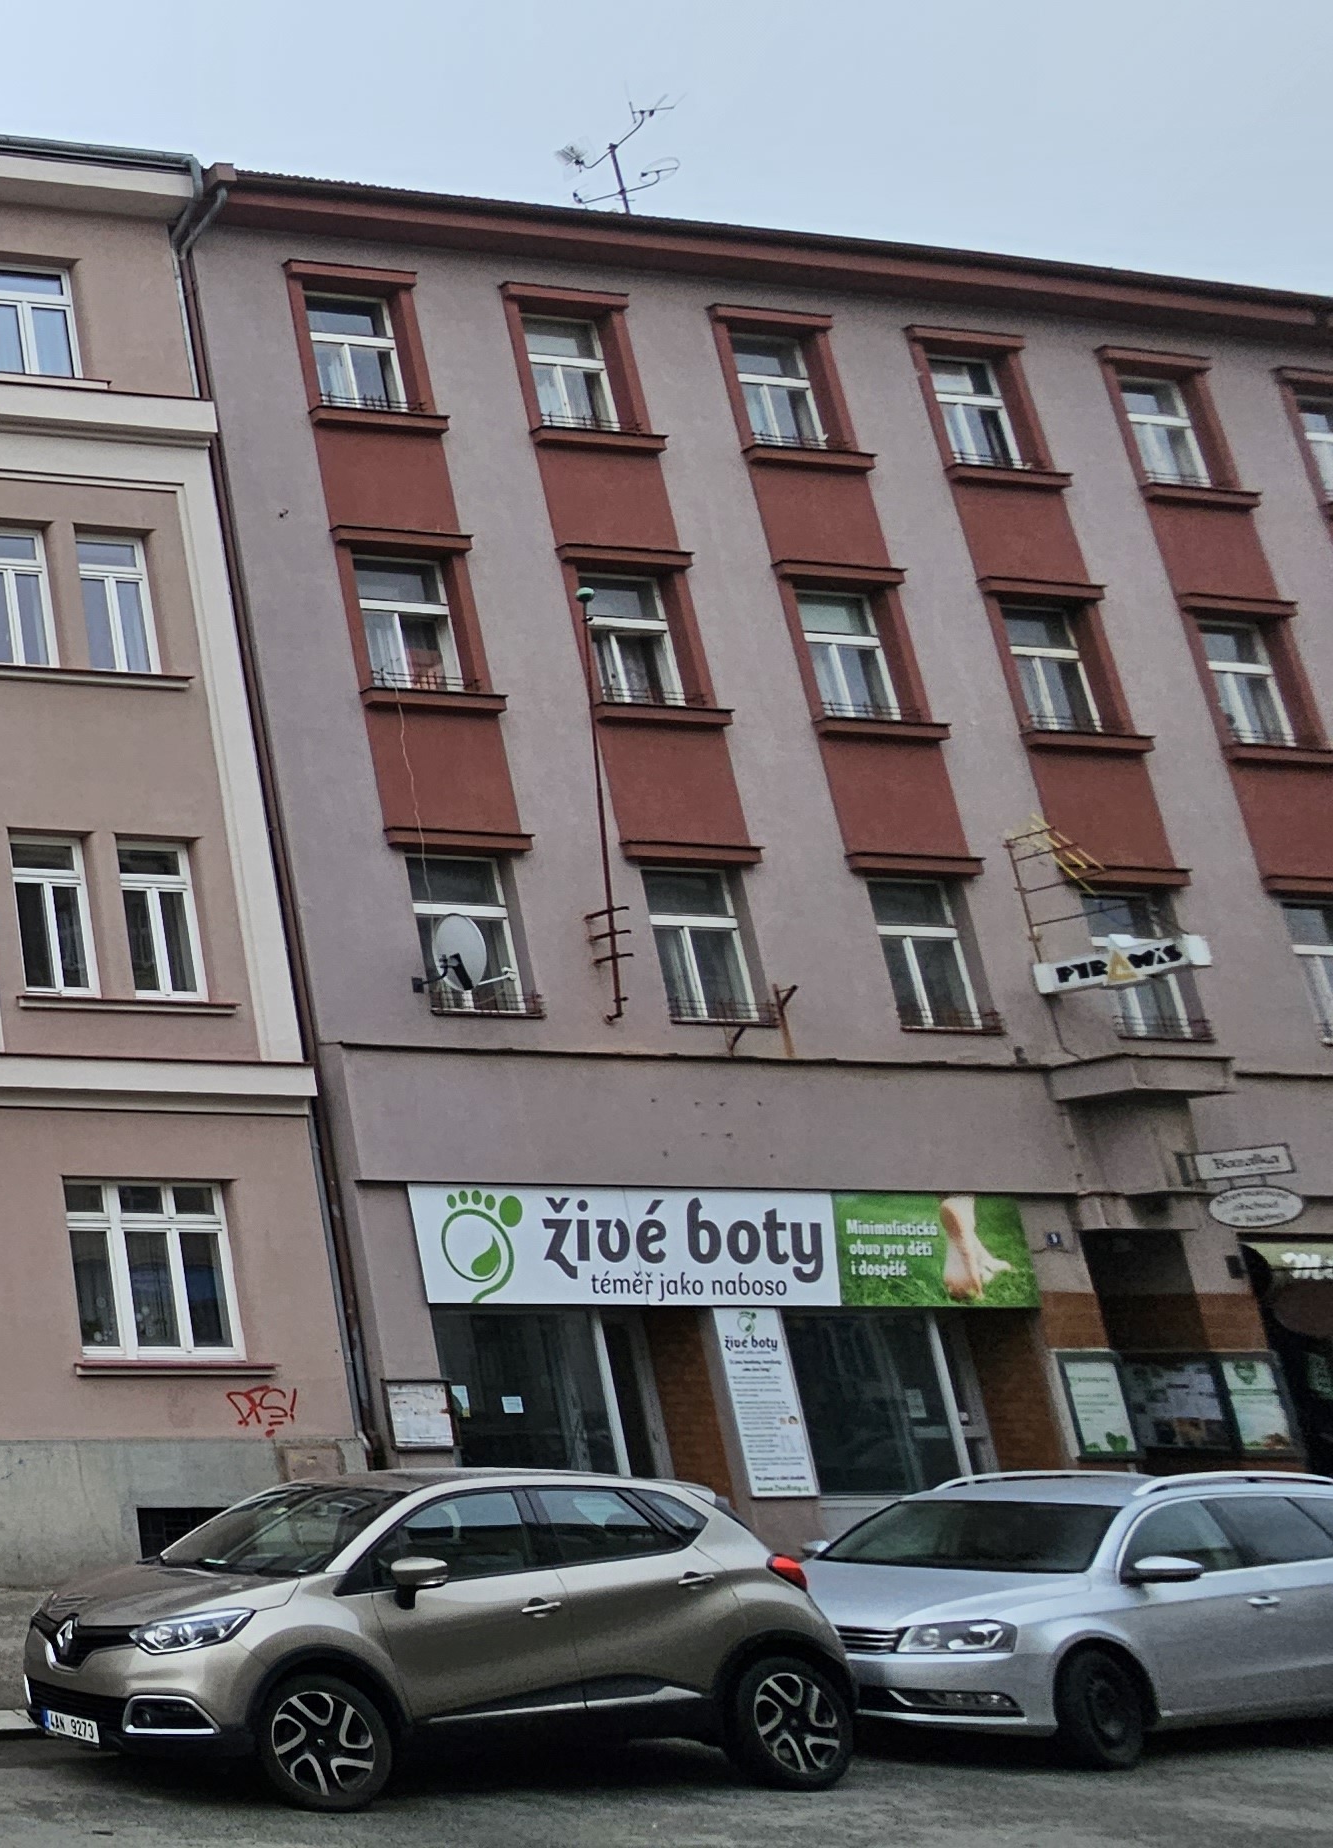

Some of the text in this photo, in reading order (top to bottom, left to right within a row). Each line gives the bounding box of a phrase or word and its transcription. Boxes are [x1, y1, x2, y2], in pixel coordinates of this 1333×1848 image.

[542, 1196, 824, 1283] živé boty
[884, 1243, 905, 1258] pro
[907, 1240, 933, 1256] děti
[851, 1260, 856, 1275] i
[591, 1270, 788, 1301] téměř jako naboso
[751, 1336, 778, 1350] boty
[71, 1718, 94, 1740] 9273
